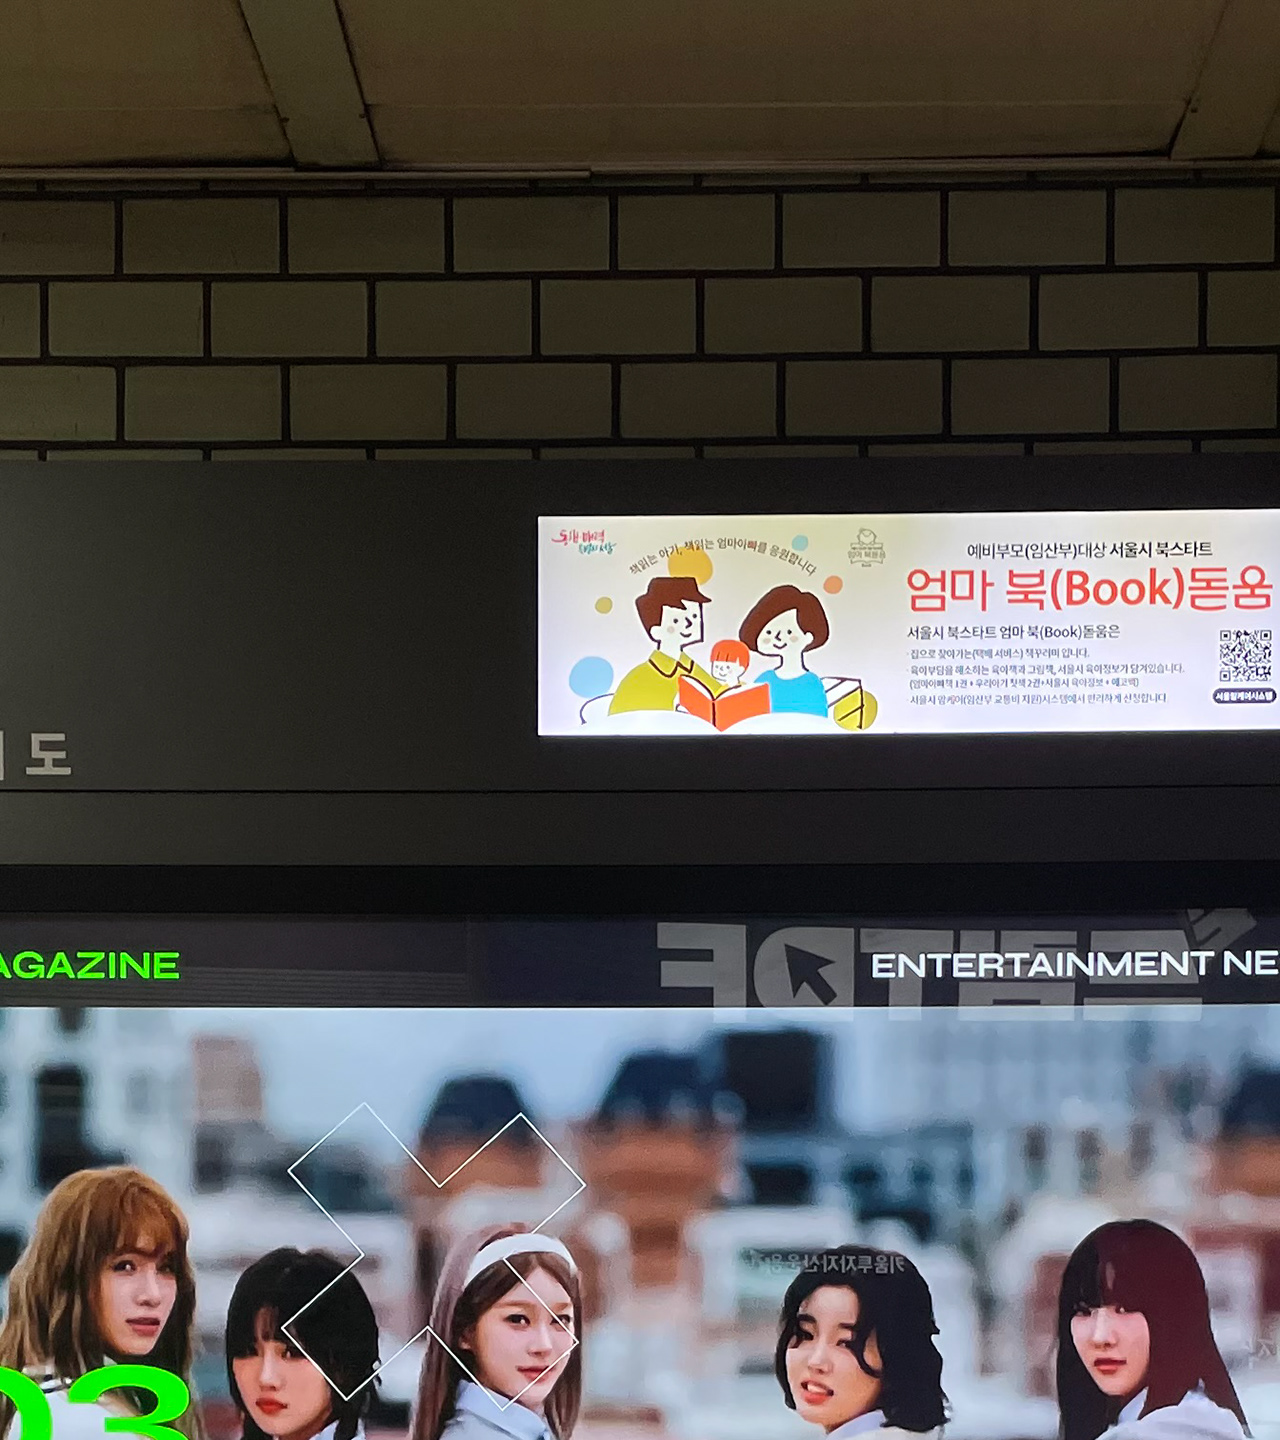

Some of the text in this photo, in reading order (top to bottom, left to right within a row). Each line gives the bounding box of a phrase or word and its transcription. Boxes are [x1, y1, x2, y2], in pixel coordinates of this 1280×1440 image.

[967, 541, 1213, 559] 예비부모(임산부)대상 서울시 북스타트
[907, 564, 1273, 613] 엄마 북(Book)돋움
[907, 624, 1120, 640] 서울시 북스타트 엄마 북(Book)돋움은
[871, 950, 1215, 980] ENTERTAINMENT
